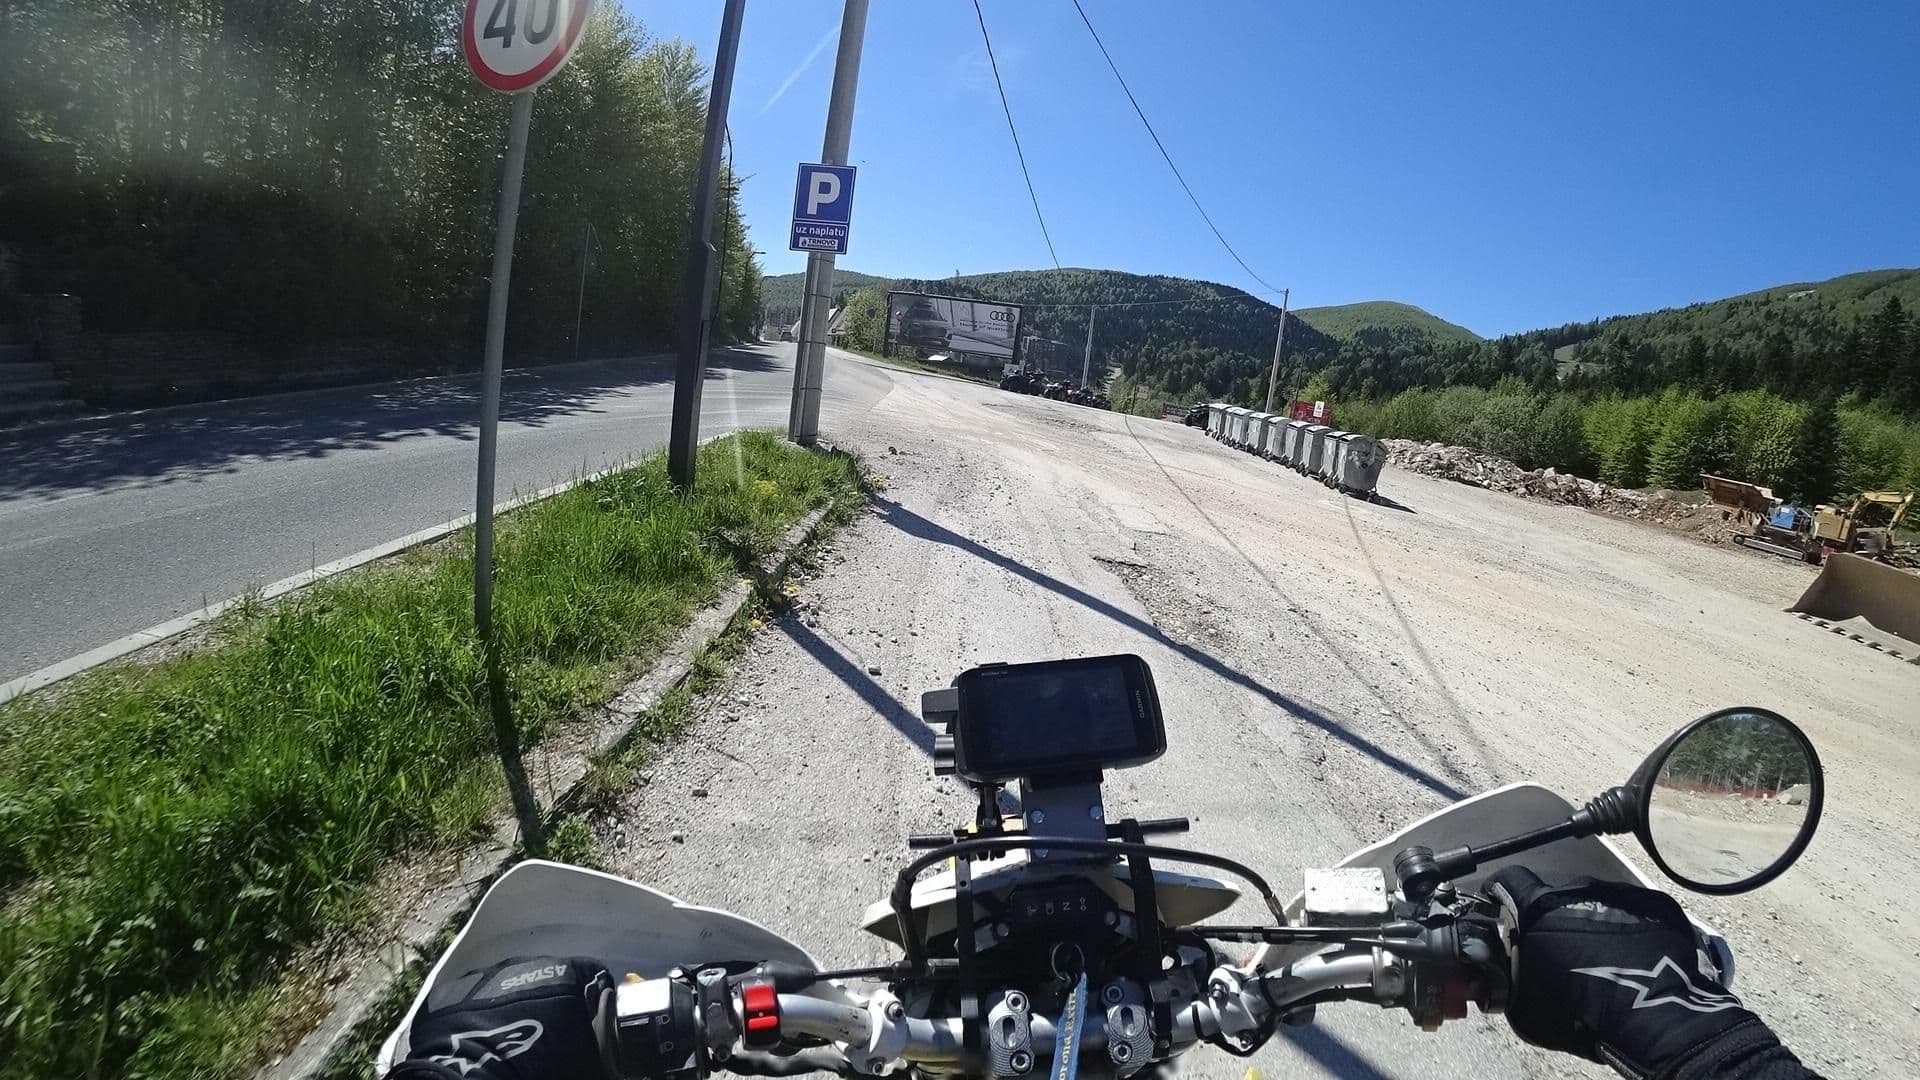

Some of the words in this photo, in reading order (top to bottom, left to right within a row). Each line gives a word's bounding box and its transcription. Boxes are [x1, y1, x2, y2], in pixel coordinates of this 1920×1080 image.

[483, 0, 558, 48] 40
[807, 171, 841, 215] P
[795, 226, 807, 234] uz
[809, 226, 845, 237] naplatu
[808, 238, 836, 246] TRNOVO
[500, 963, 569, 991] ASTARS
[1059, 1036, 1072, 1080] orona
